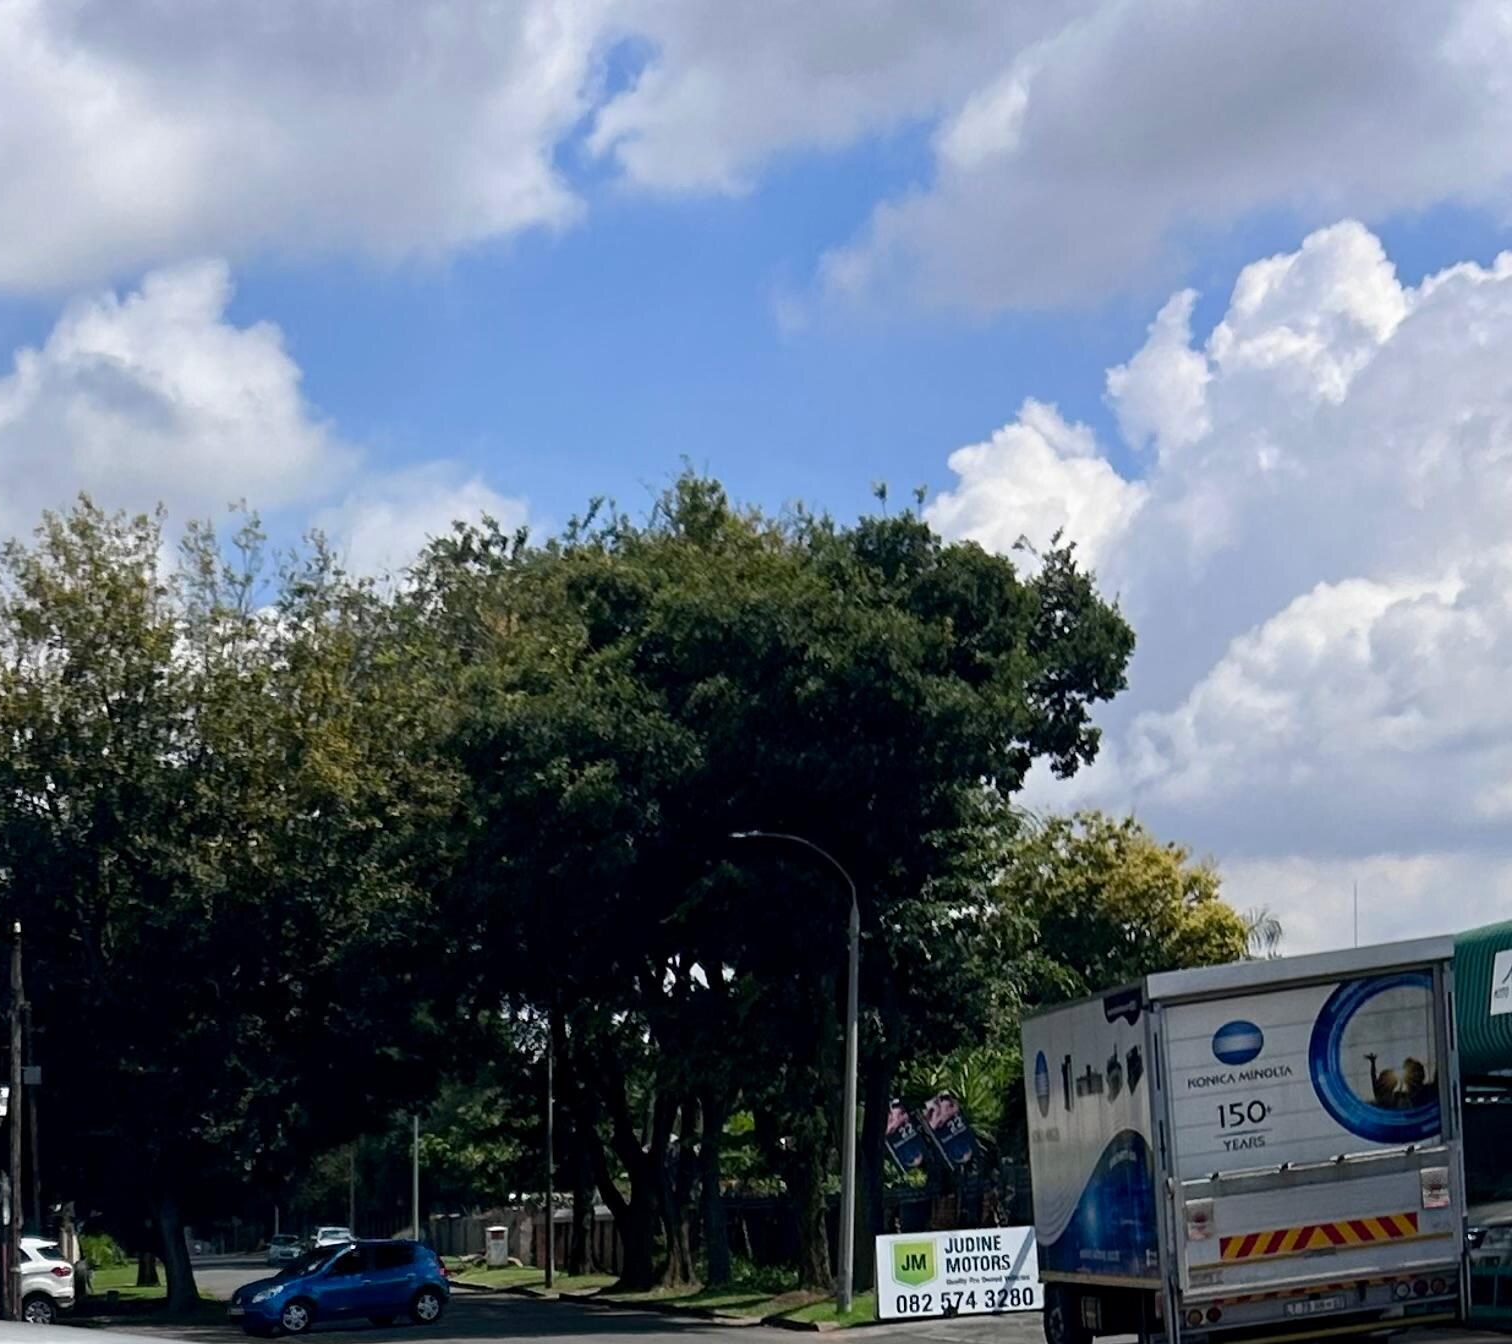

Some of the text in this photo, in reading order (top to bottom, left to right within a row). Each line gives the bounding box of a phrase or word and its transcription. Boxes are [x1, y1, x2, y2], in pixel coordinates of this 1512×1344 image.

[1188, 1066, 1293, 1089] KONICA MINOLTA
[1223, 1136, 1265, 1151] YEARS
[944, 1235, 1001, 1254] JUDINE
[901, 1254, 926, 1271] JM
[946, 1254, 1011, 1273] MOTORS
[896, 1287, 1034, 1313] 082 574 3280
